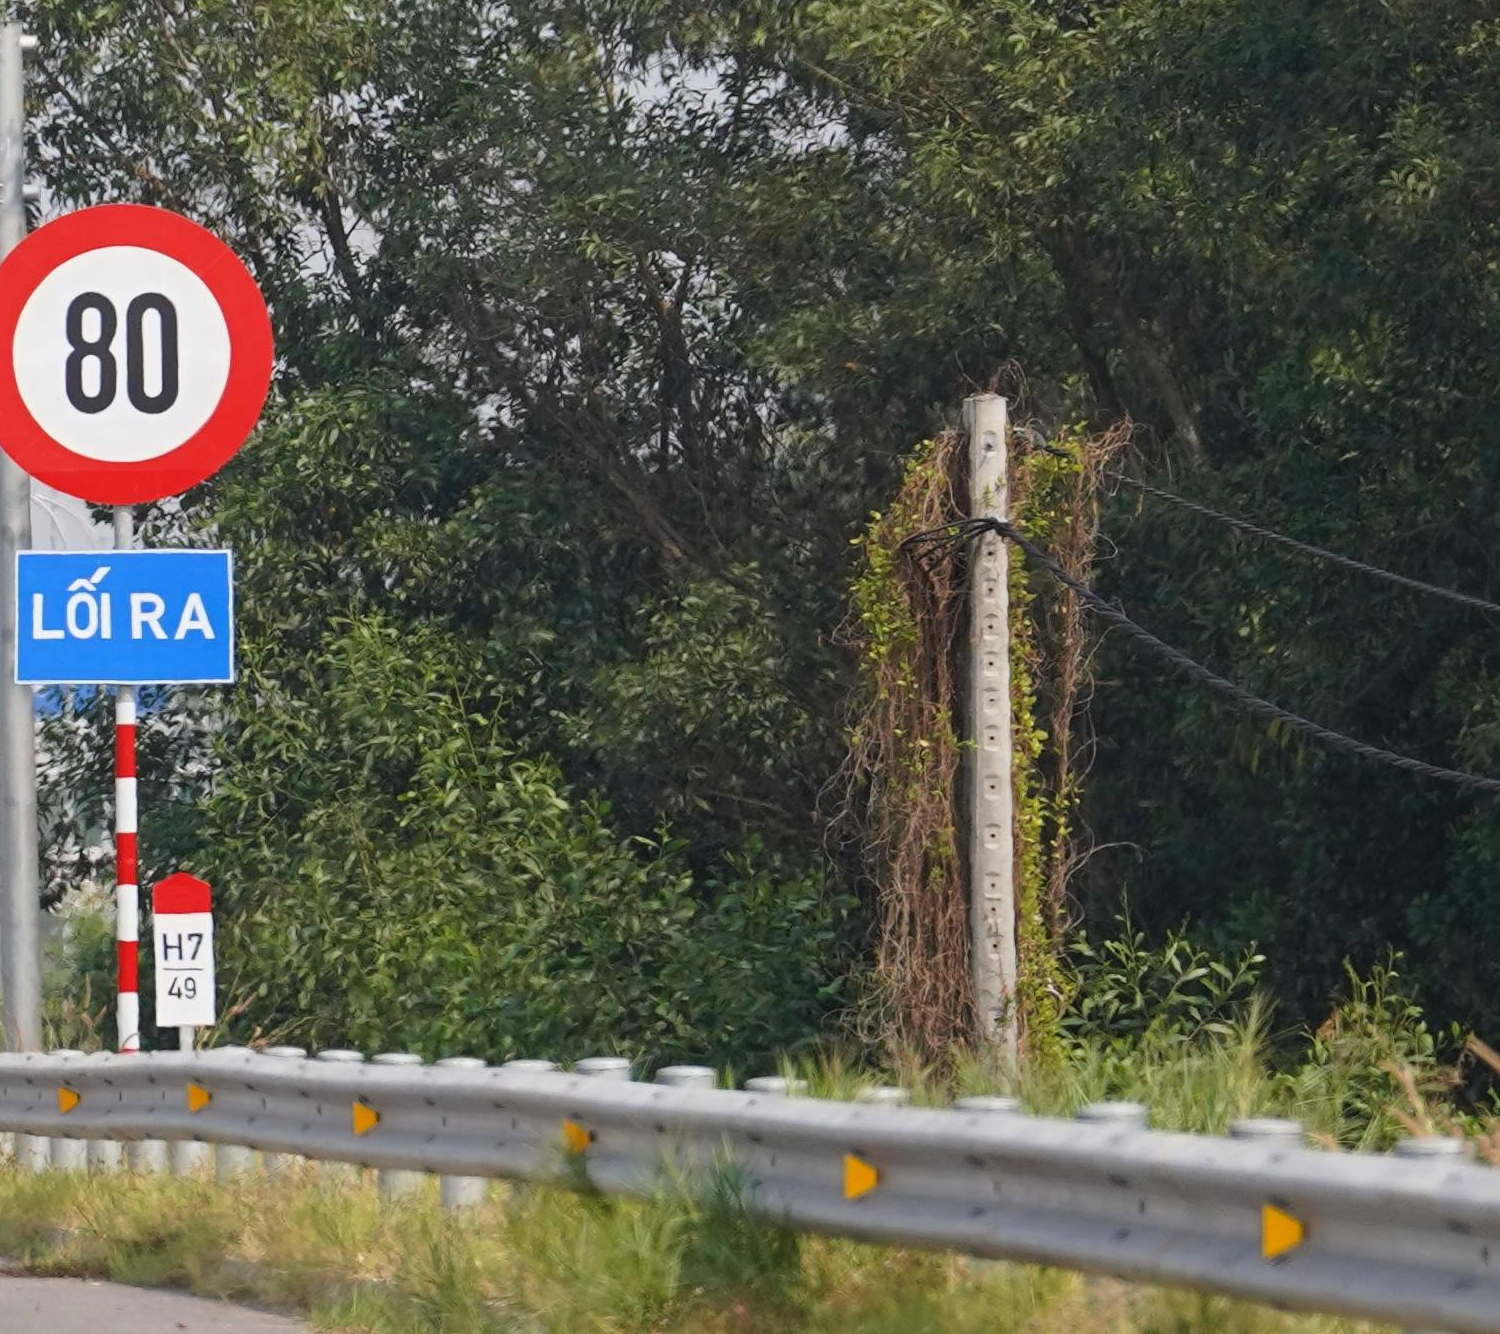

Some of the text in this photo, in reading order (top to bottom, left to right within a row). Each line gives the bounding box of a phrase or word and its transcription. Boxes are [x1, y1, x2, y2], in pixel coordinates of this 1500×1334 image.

[65, 291, 179, 414] 80
[32, 566, 216, 640] LỐI RA
[162, 932, 204, 961] H7
[167, 976, 198, 1000] 49
